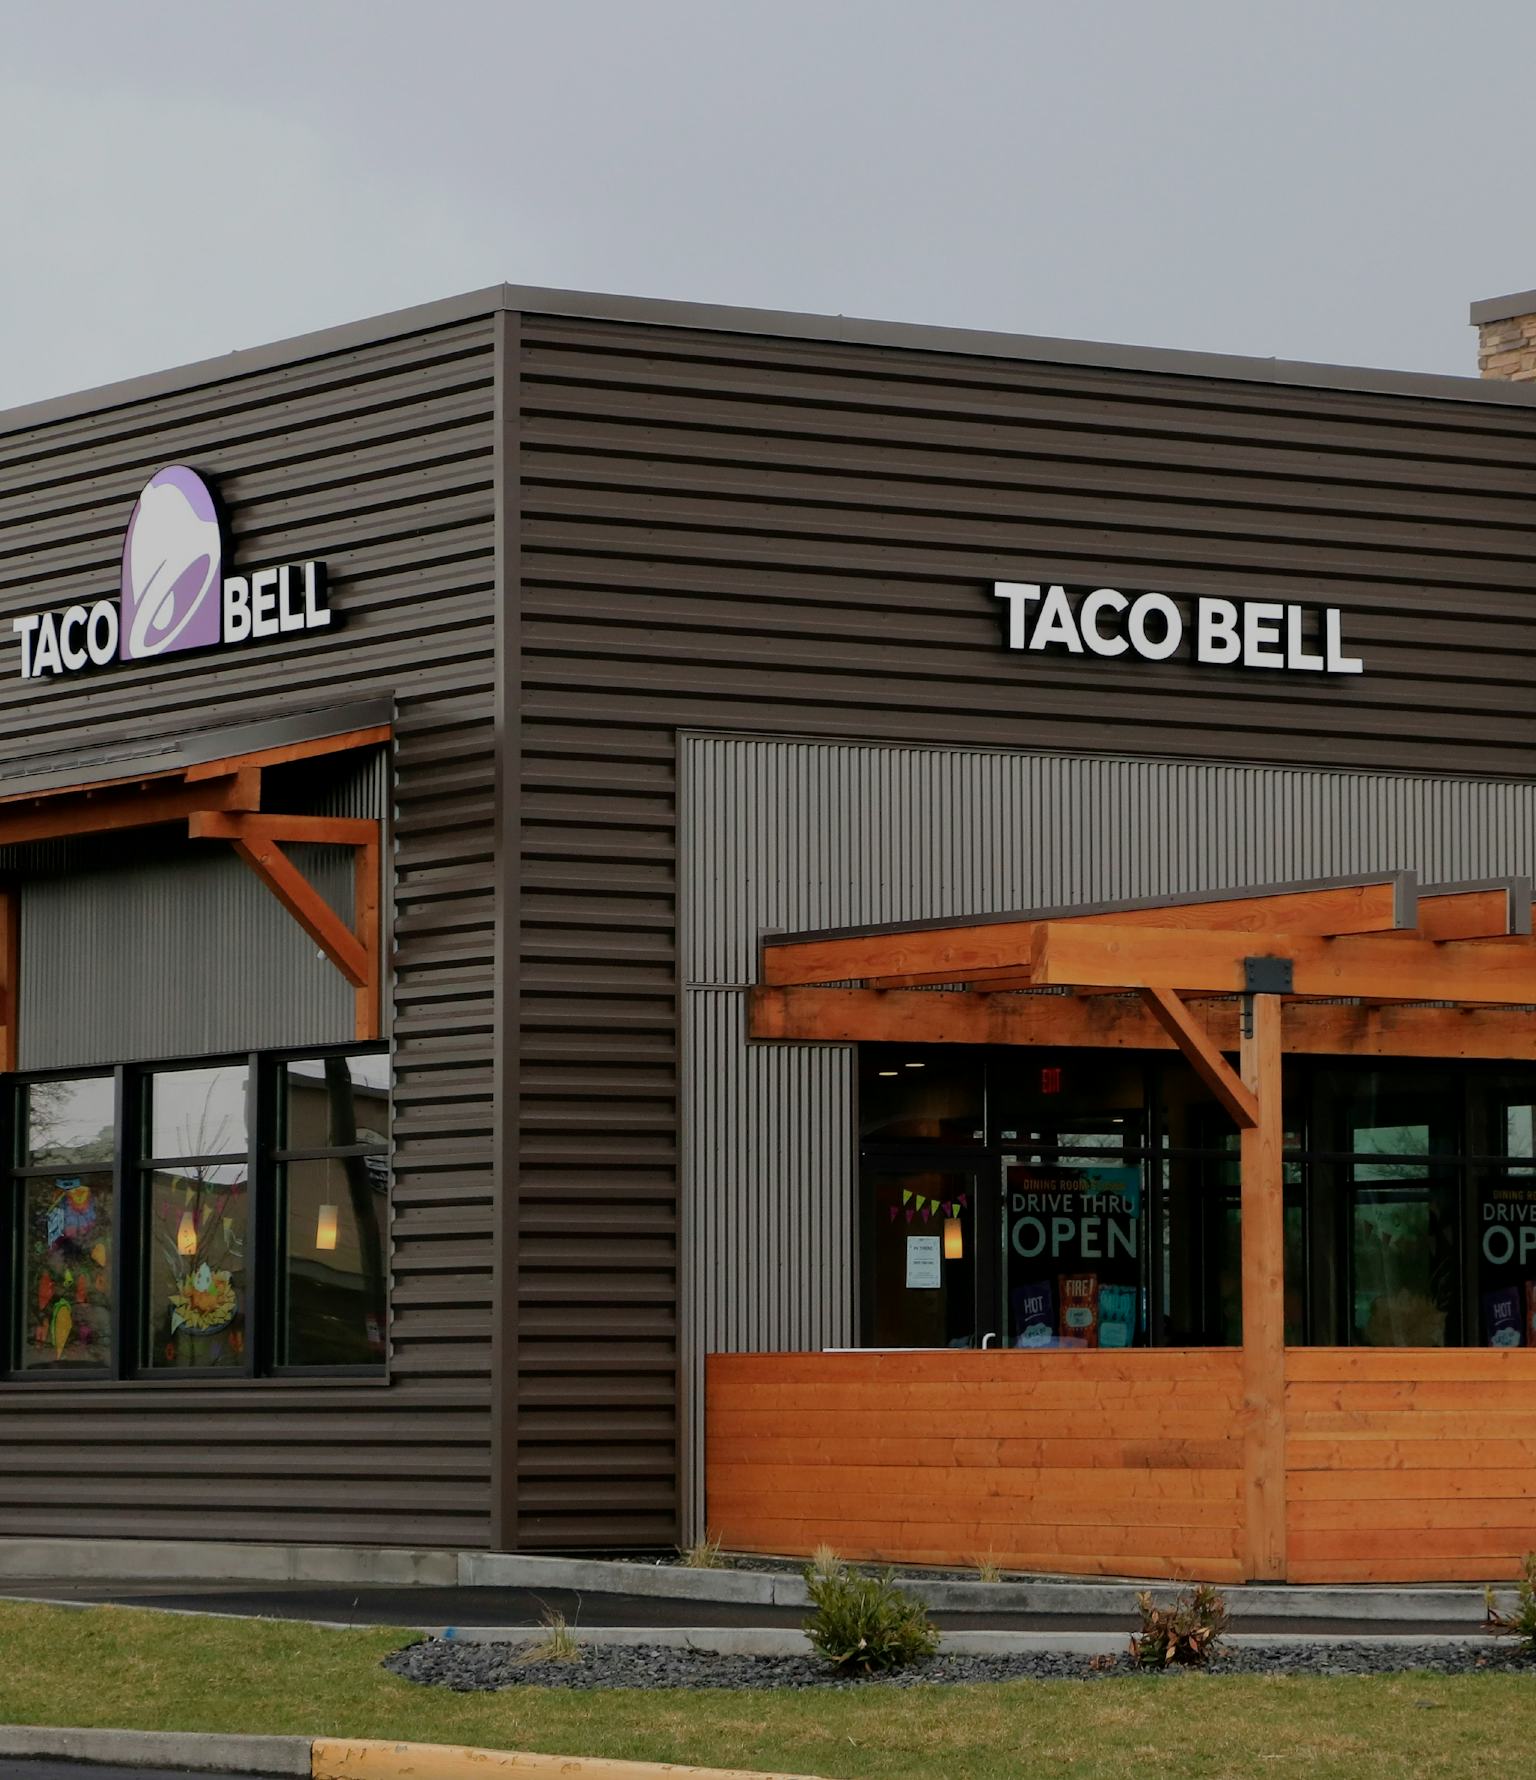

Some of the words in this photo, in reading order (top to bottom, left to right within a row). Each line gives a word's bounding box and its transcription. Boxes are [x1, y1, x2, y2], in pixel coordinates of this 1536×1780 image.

[13, 600, 119, 679] TACO
[223, 561, 331, 643] BELL
[994, 581, 1183, 660] TACO
[1198, 597, 1364, 674] BELL
[1023, 1179, 1056, 1191] DINING
[1012, 1193, 1073, 1213] DRIVE
[1080, 1194, 1135, 1214] THRU
[1493, 1190, 1524, 1201] DINING
[1011, 1216, 1137, 1258] OPEN
[1023, 1296, 1044, 1314] HOT
[1493, 1302, 1512, 1318] HOT
